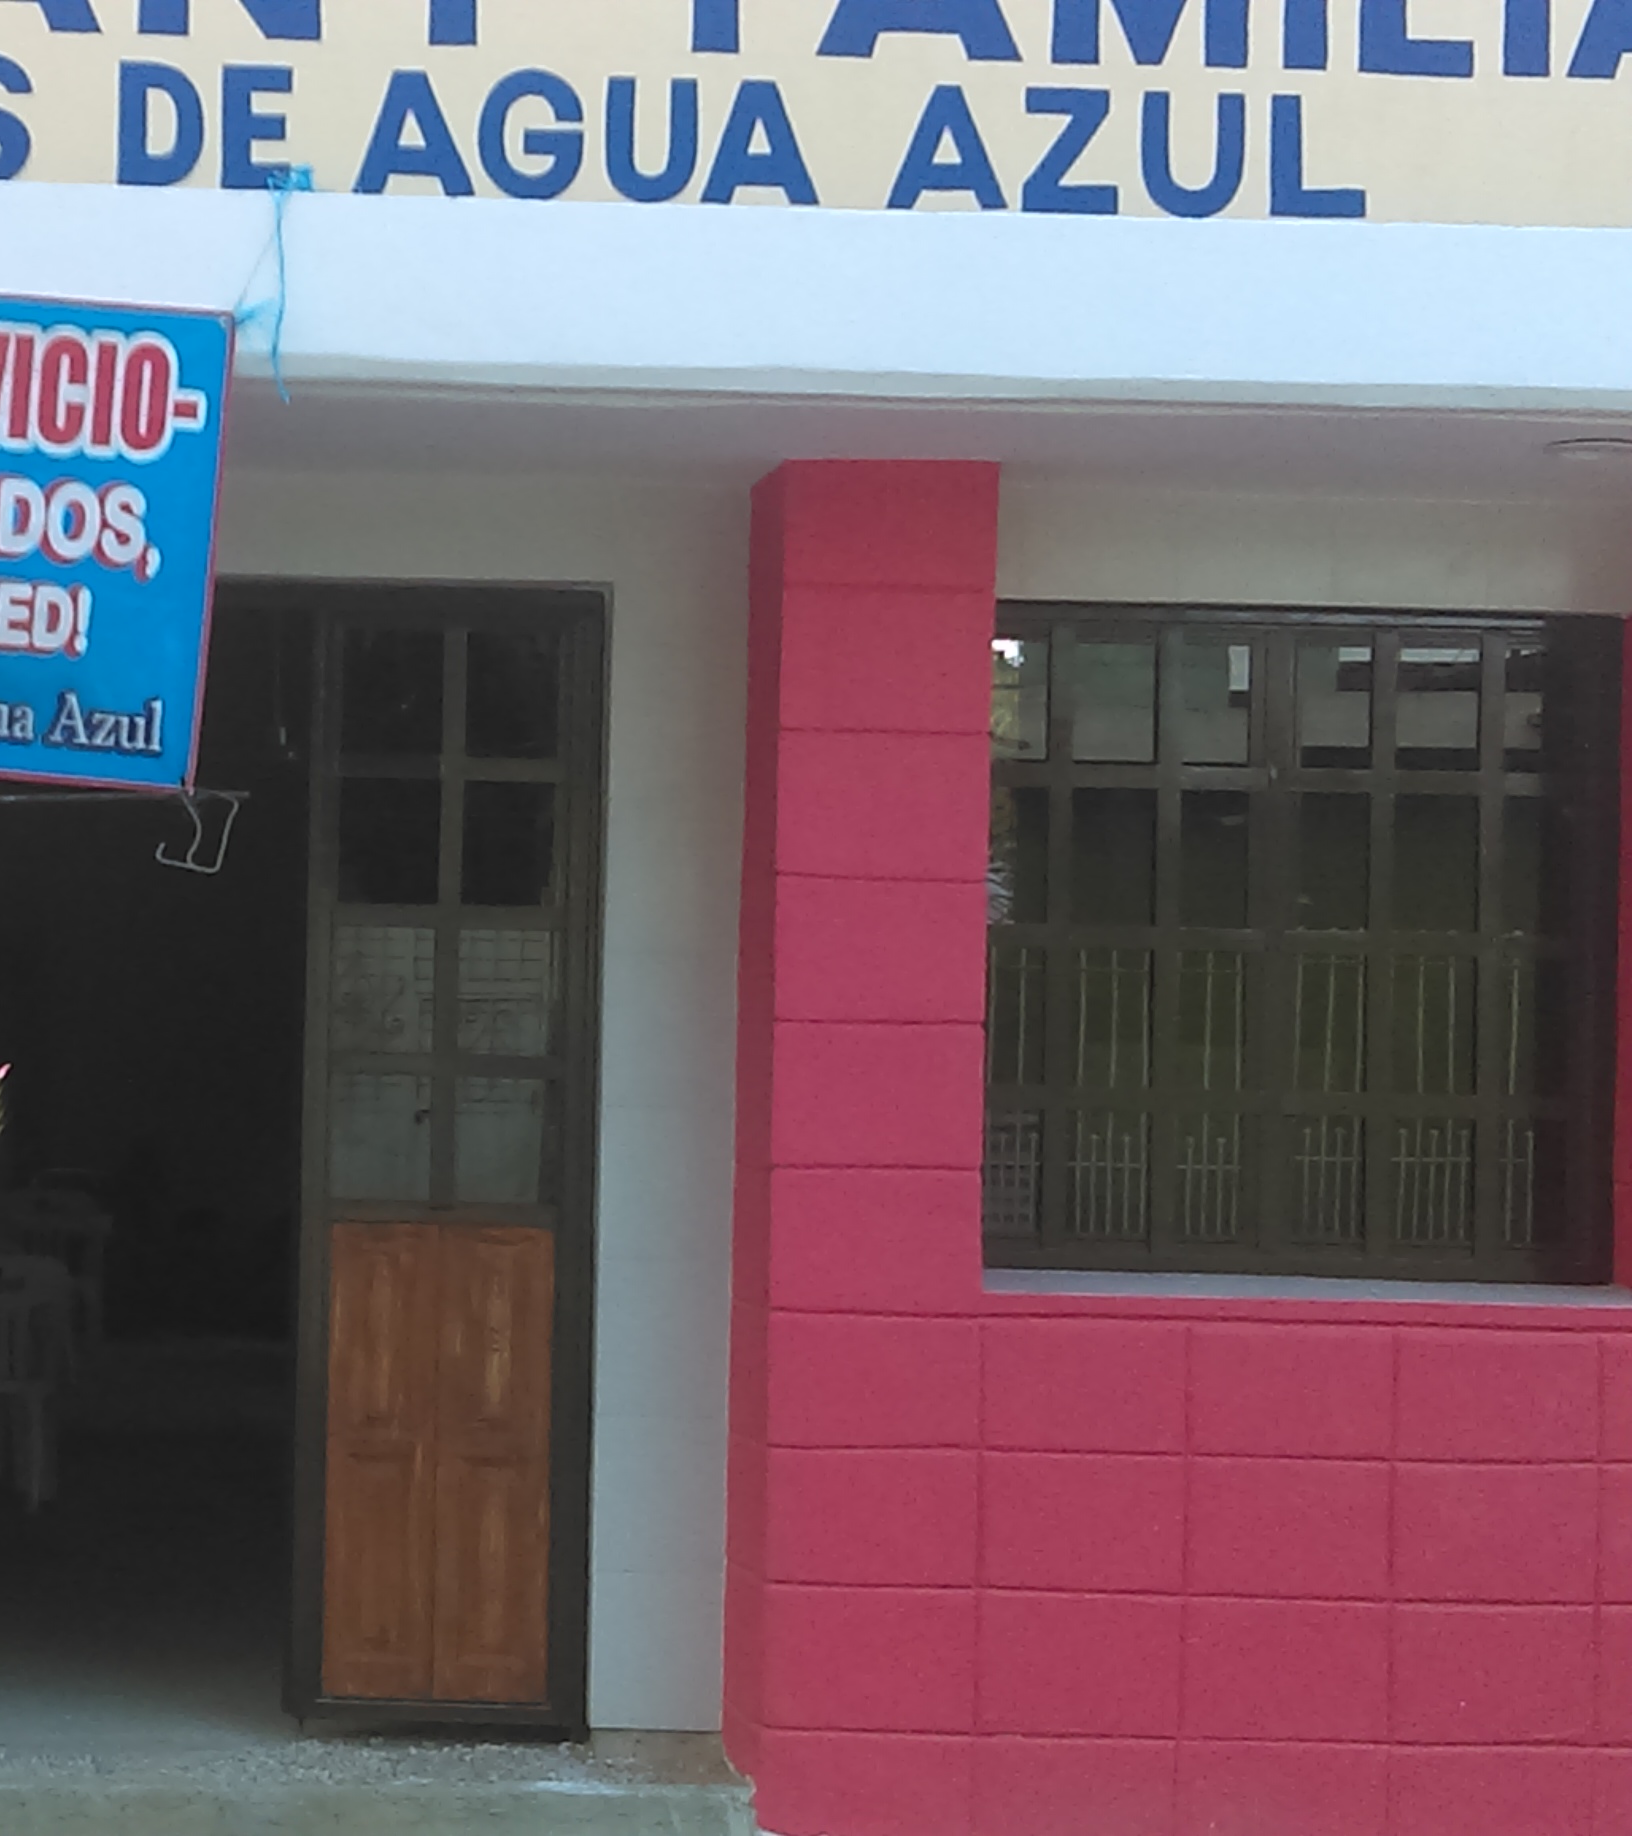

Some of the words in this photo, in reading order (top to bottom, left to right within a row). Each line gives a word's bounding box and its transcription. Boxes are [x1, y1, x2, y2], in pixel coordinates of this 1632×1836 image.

[116, 62, 294, 190] DE
[351, 70, 818, 205] AGUA
[886, 86, 1366, 218] AZUL
[49, 693, 164, 752] Azul
